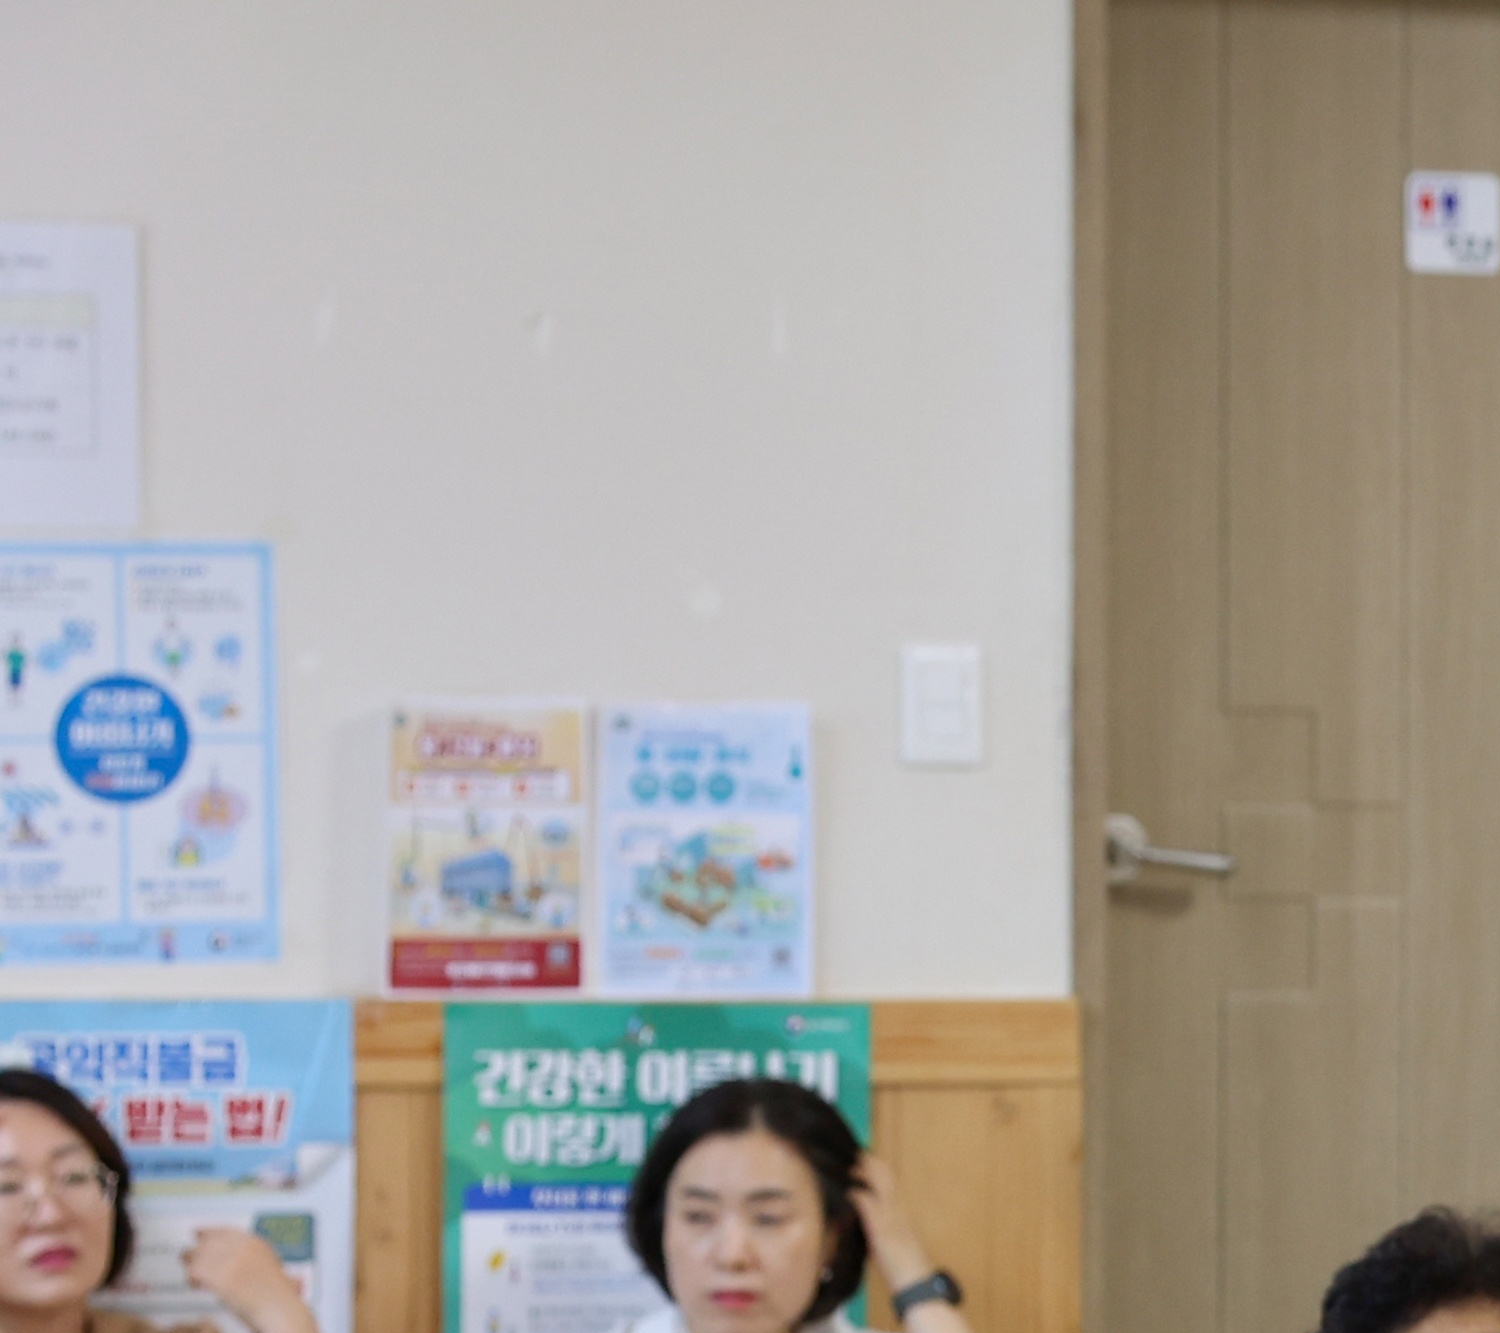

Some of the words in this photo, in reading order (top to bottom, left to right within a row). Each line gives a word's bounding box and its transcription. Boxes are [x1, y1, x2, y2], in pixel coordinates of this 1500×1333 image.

[474, 1048, 629, 1107] 건강한
[126, 1097, 209, 1142] 받는
[503, 1112, 647, 1167] 이렇게
